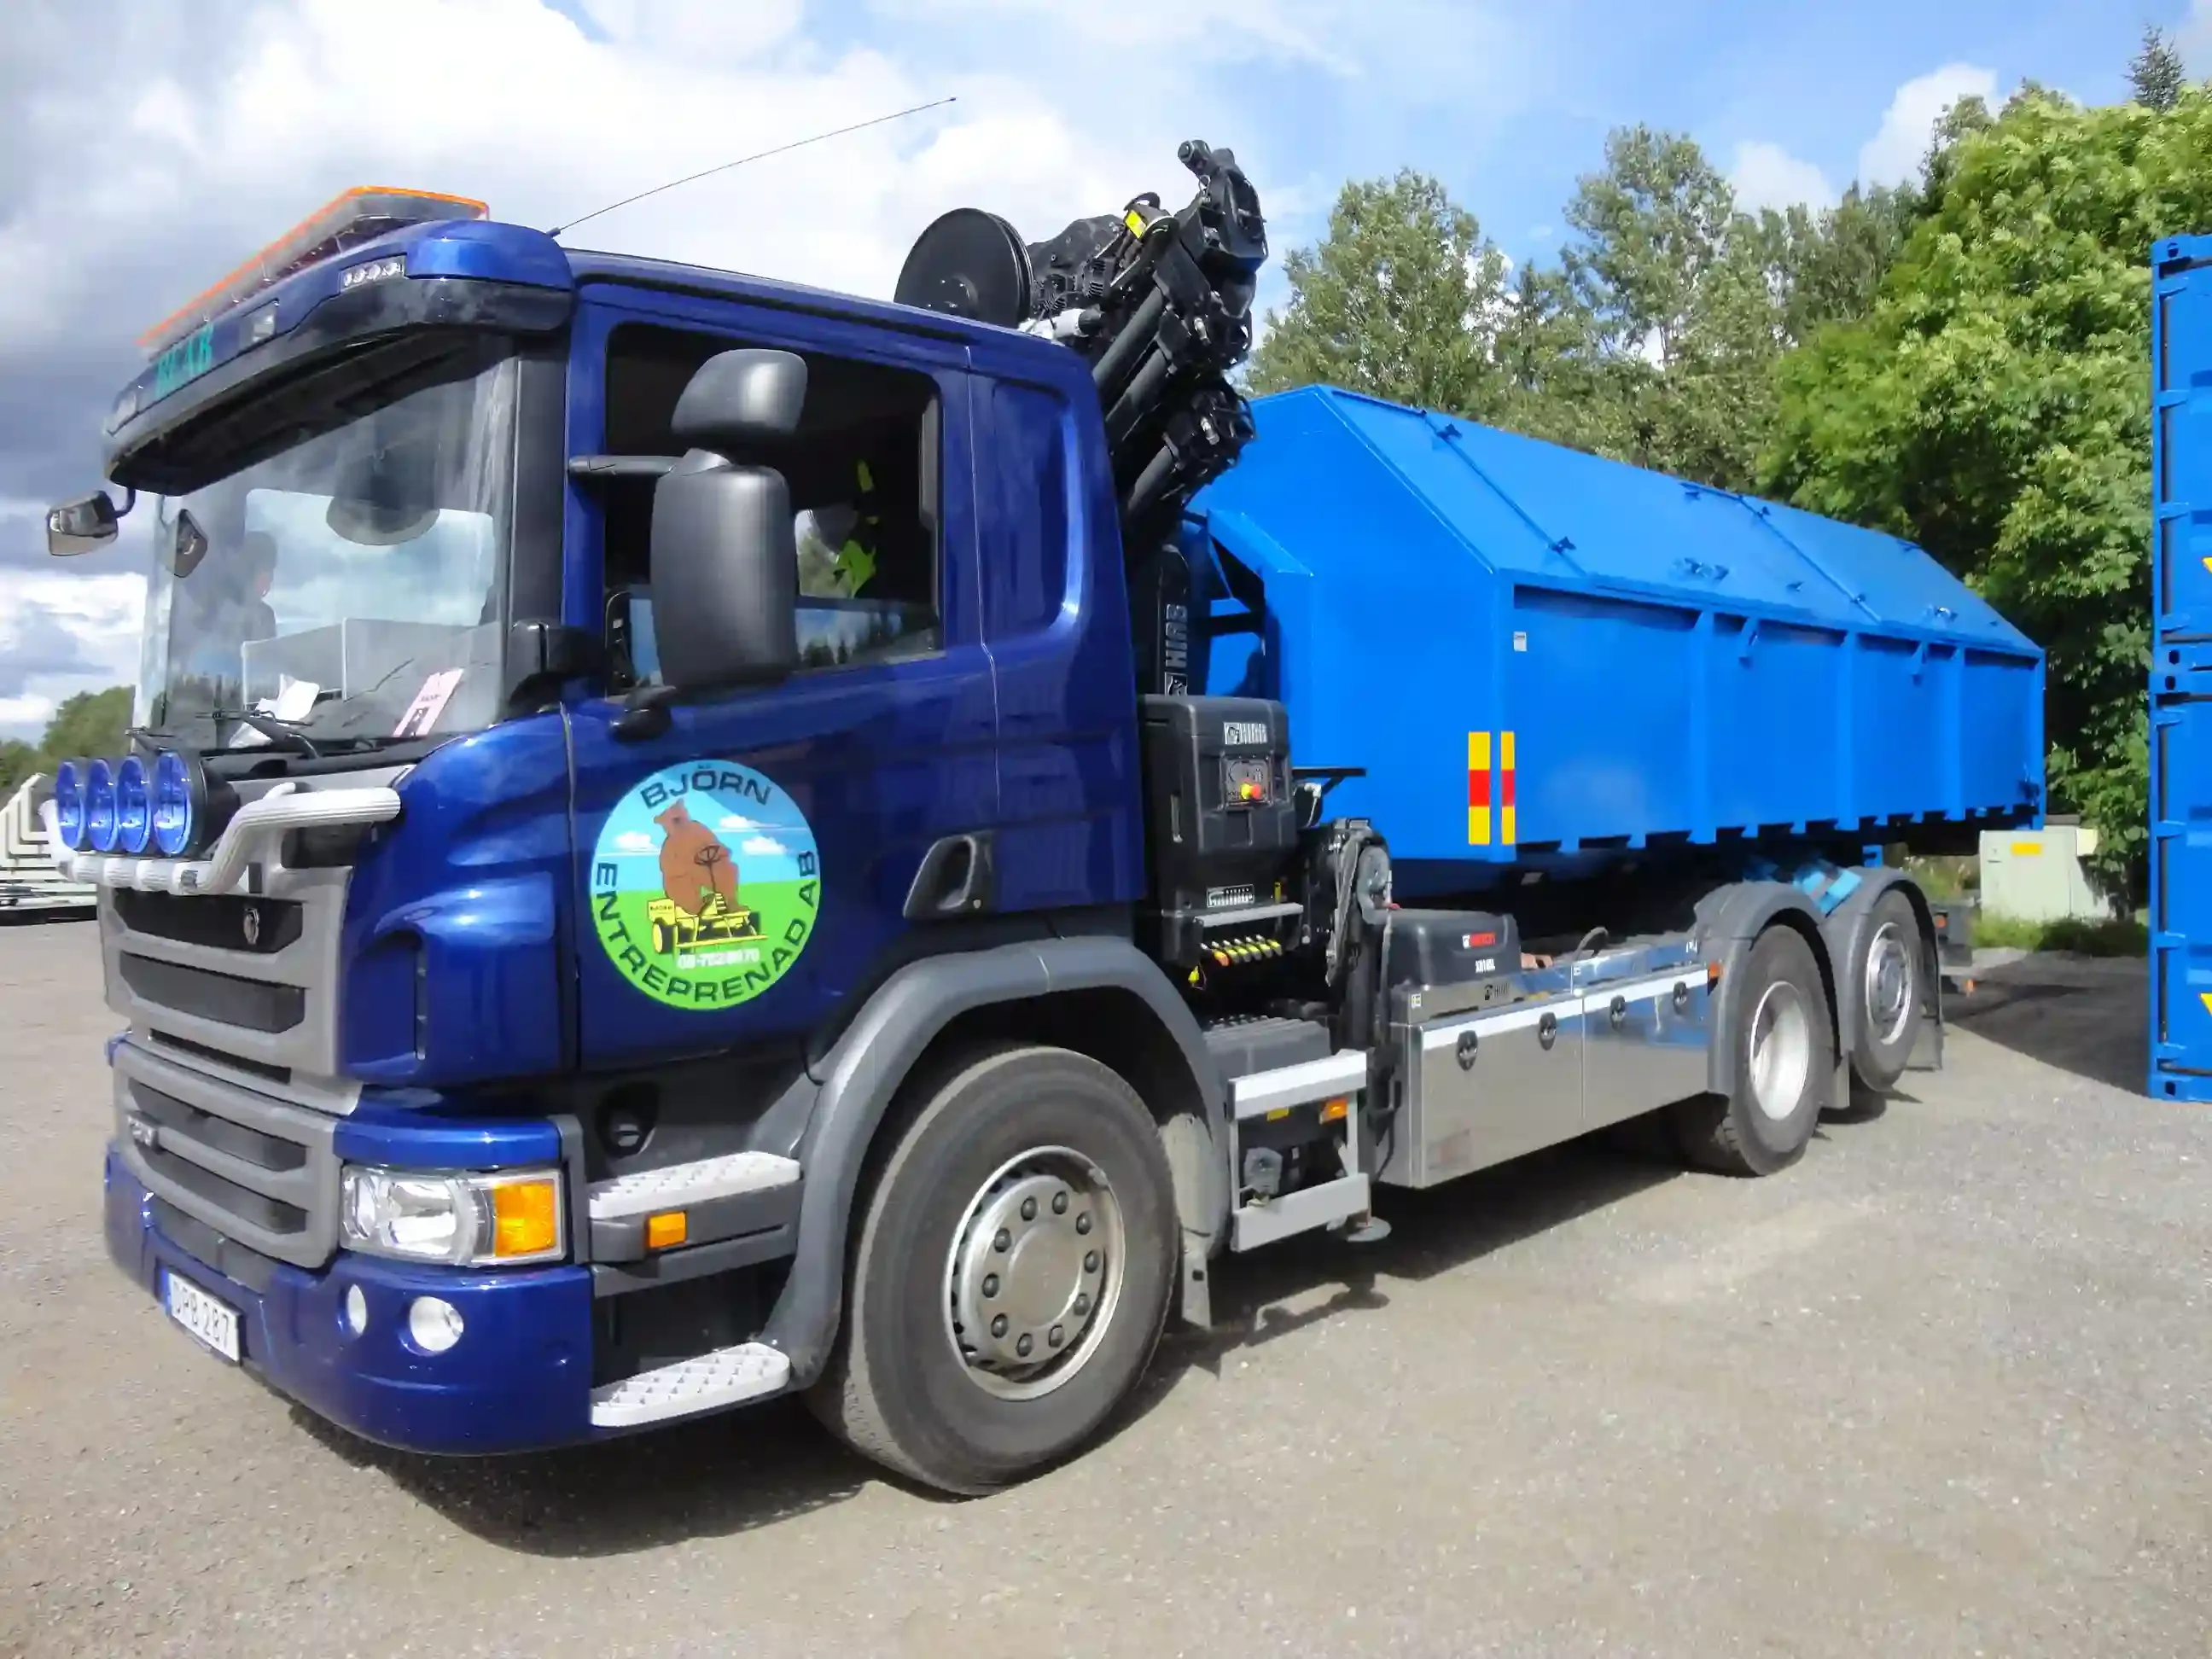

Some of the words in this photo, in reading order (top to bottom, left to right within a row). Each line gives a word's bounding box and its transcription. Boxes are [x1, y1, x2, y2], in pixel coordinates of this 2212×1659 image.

[640, 763, 772, 806] BJÖRN
[596, 861, 806, 1002] ENTREPRENAD
[796, 850, 818, 909] AB
